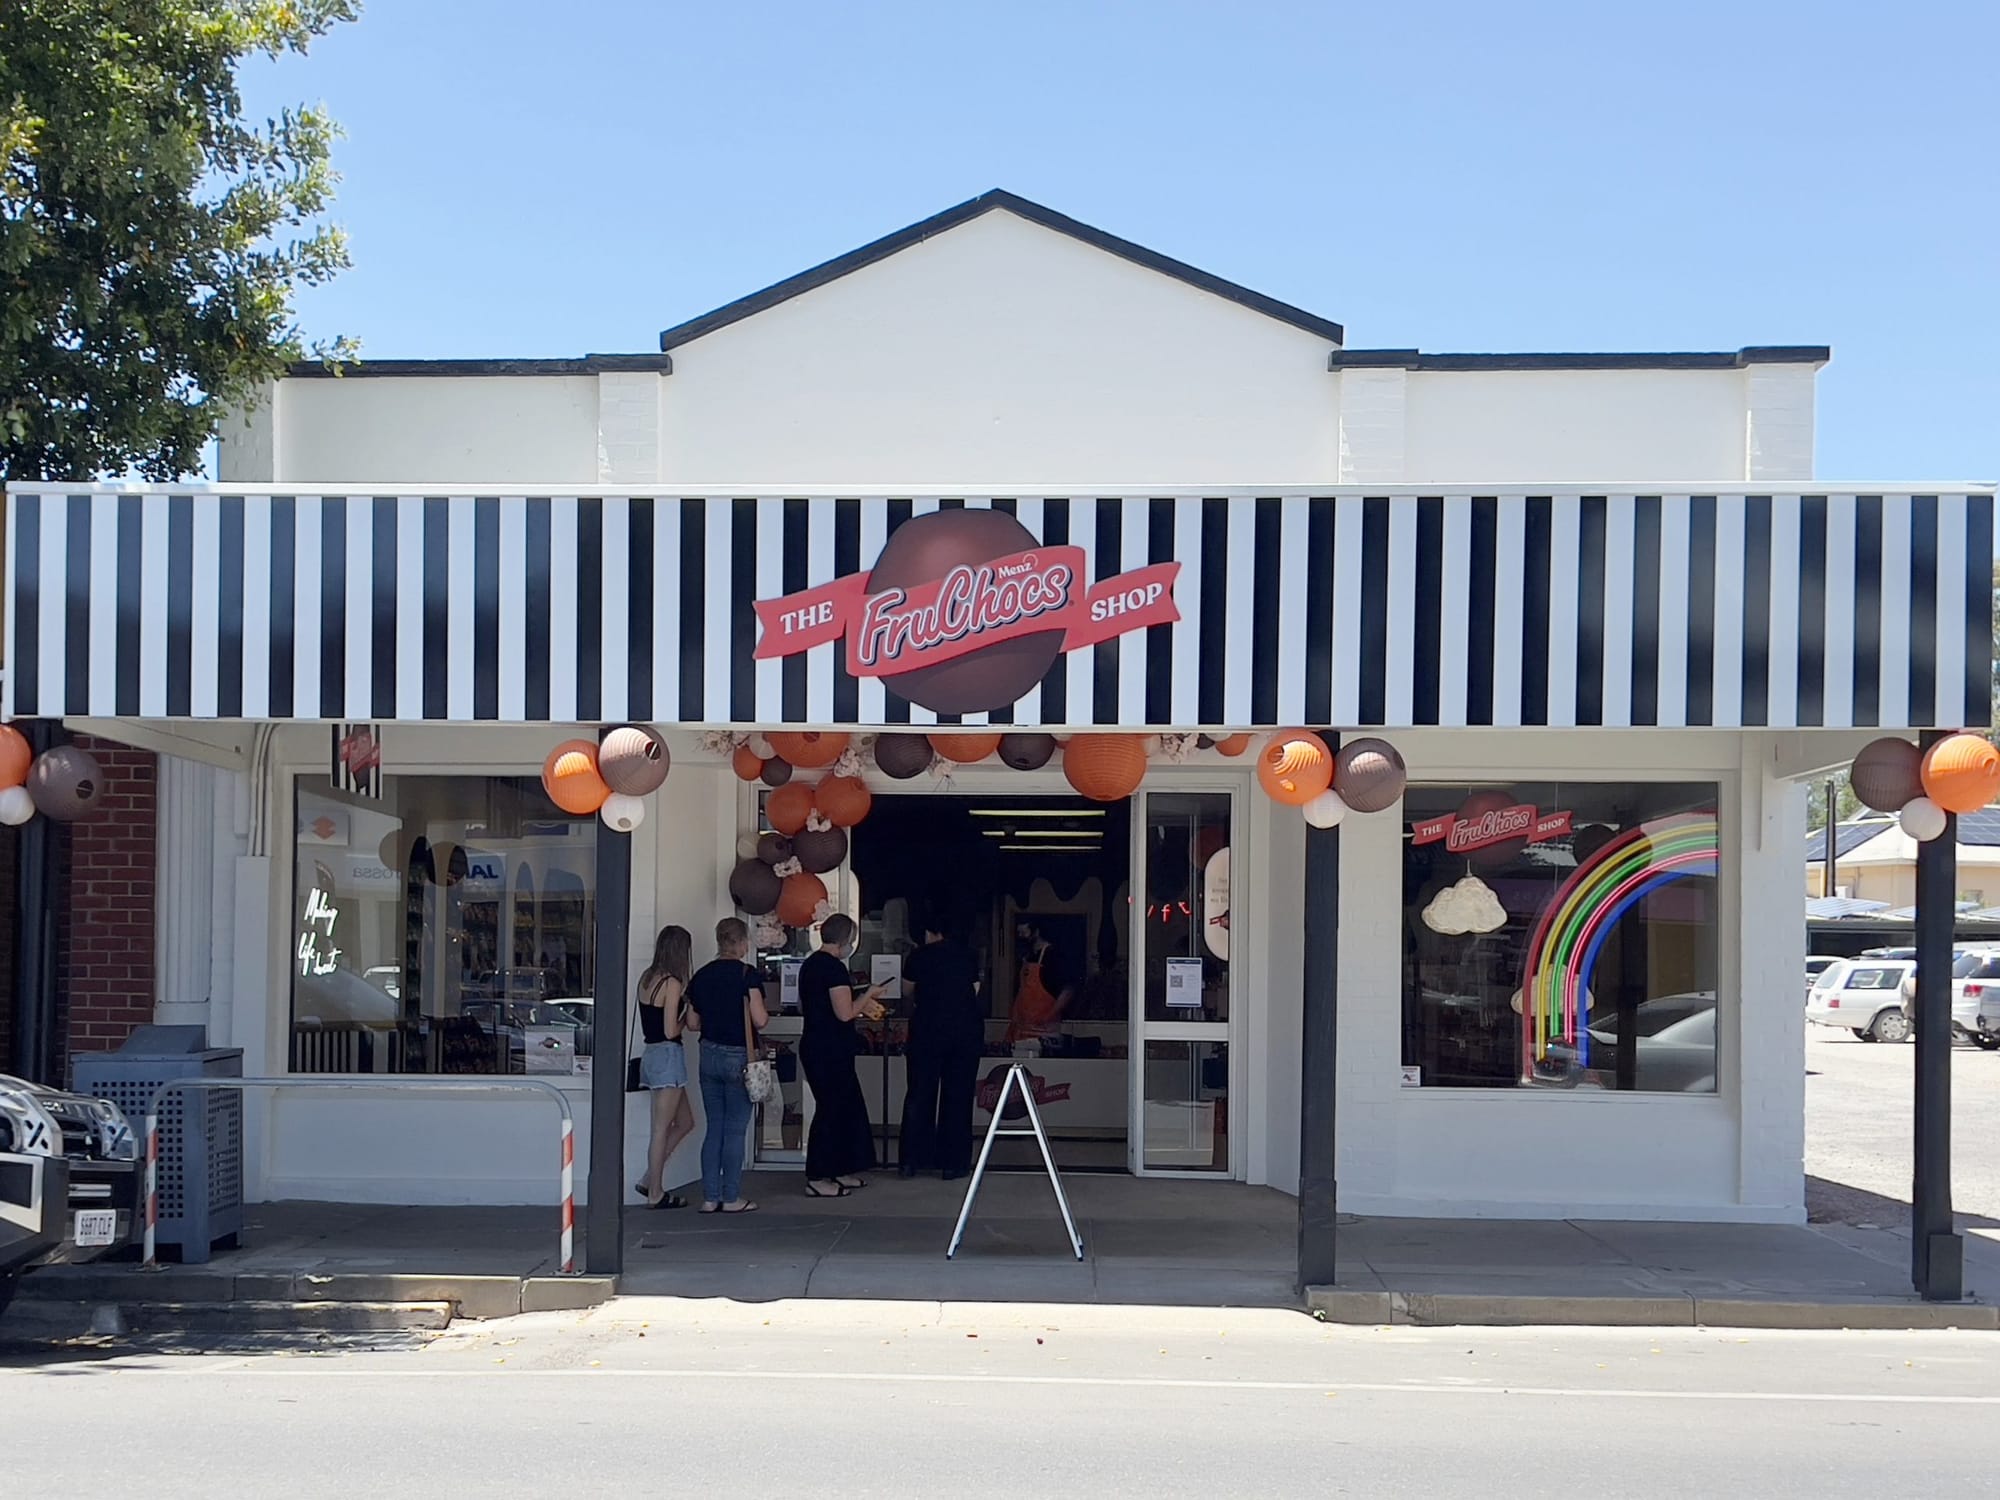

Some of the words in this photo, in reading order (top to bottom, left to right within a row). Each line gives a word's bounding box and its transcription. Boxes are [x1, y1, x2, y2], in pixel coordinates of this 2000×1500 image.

[998, 562, 1033, 579] Menz
[779, 600, 834, 635] THE
[857, 564, 1074, 665] FruChocs
[1089, 582, 1163, 623] SHOP
[1421, 823, 1443, 837] THE
[1450, 810, 1530, 848] FruChocs
[1536, 817, 1566, 833] SHOP
